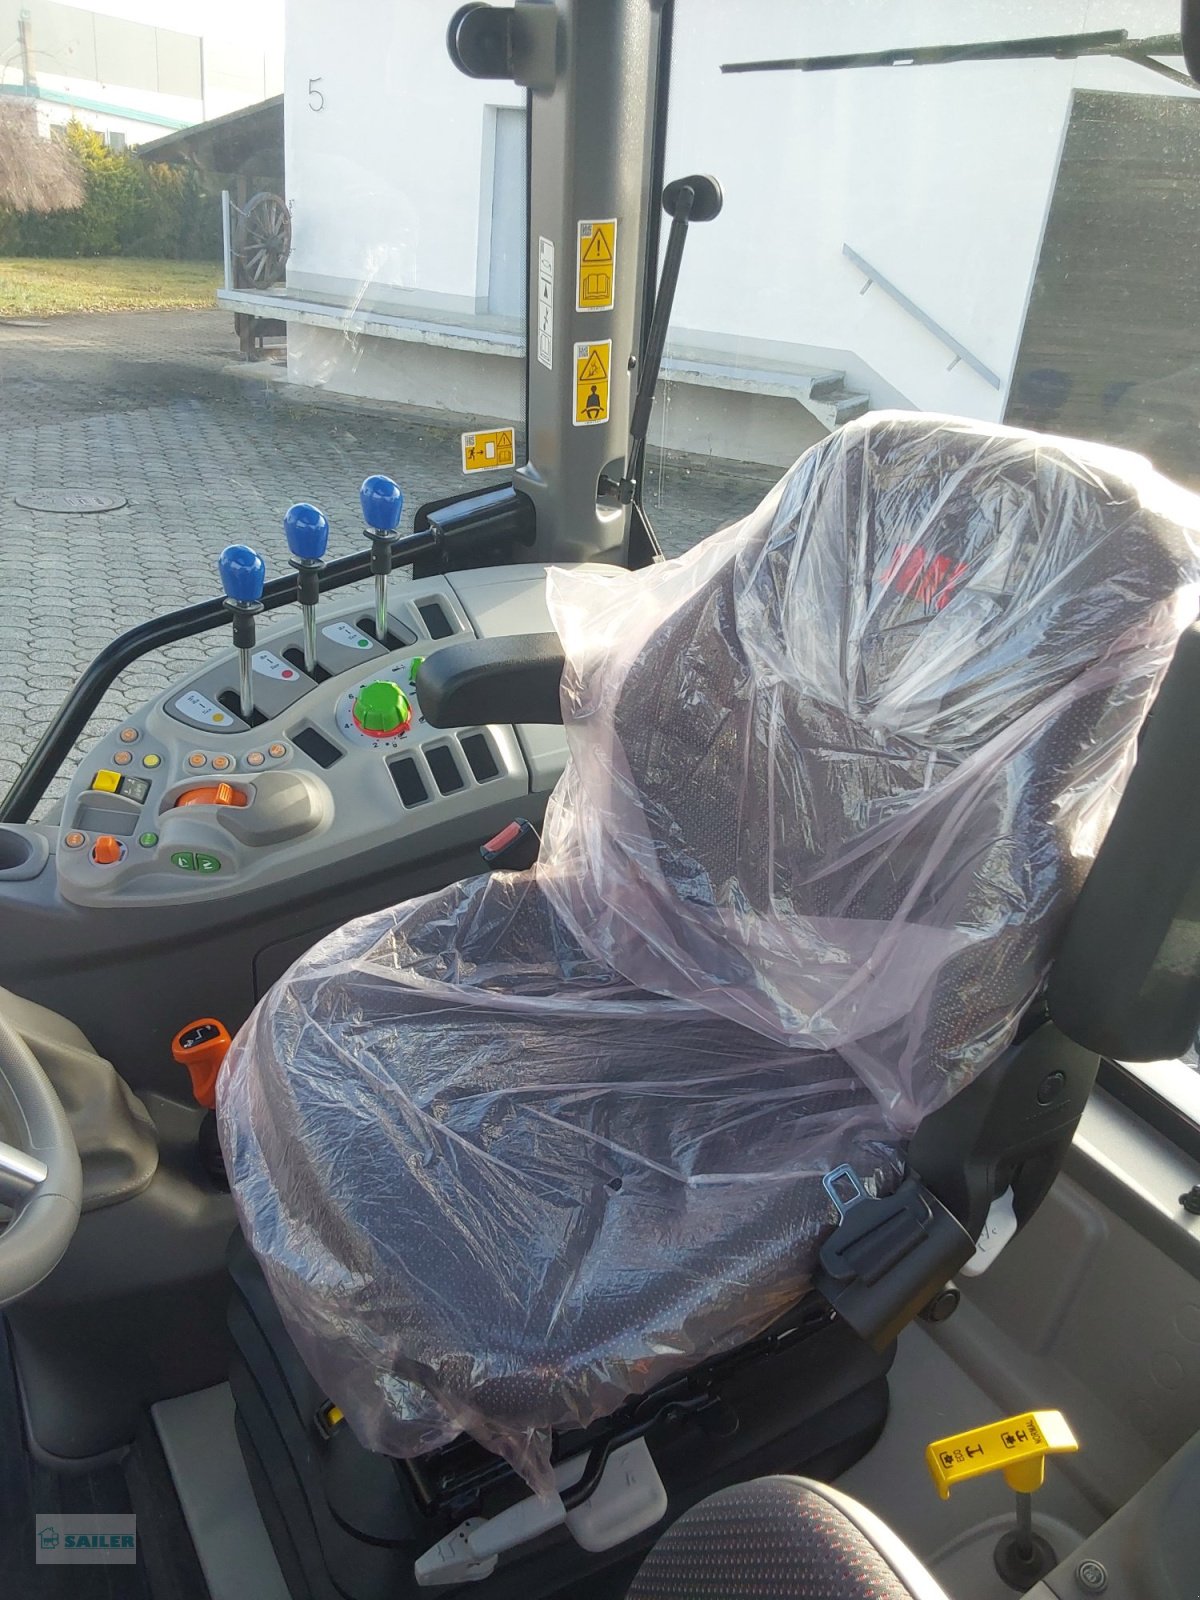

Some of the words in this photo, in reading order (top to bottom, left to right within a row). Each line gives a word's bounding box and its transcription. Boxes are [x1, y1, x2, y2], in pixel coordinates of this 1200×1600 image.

[308, 77, 324, 112] 5
[1026, 1419, 1043, 1445] NORMAL
[953, 1449, 965, 1462] ECO
